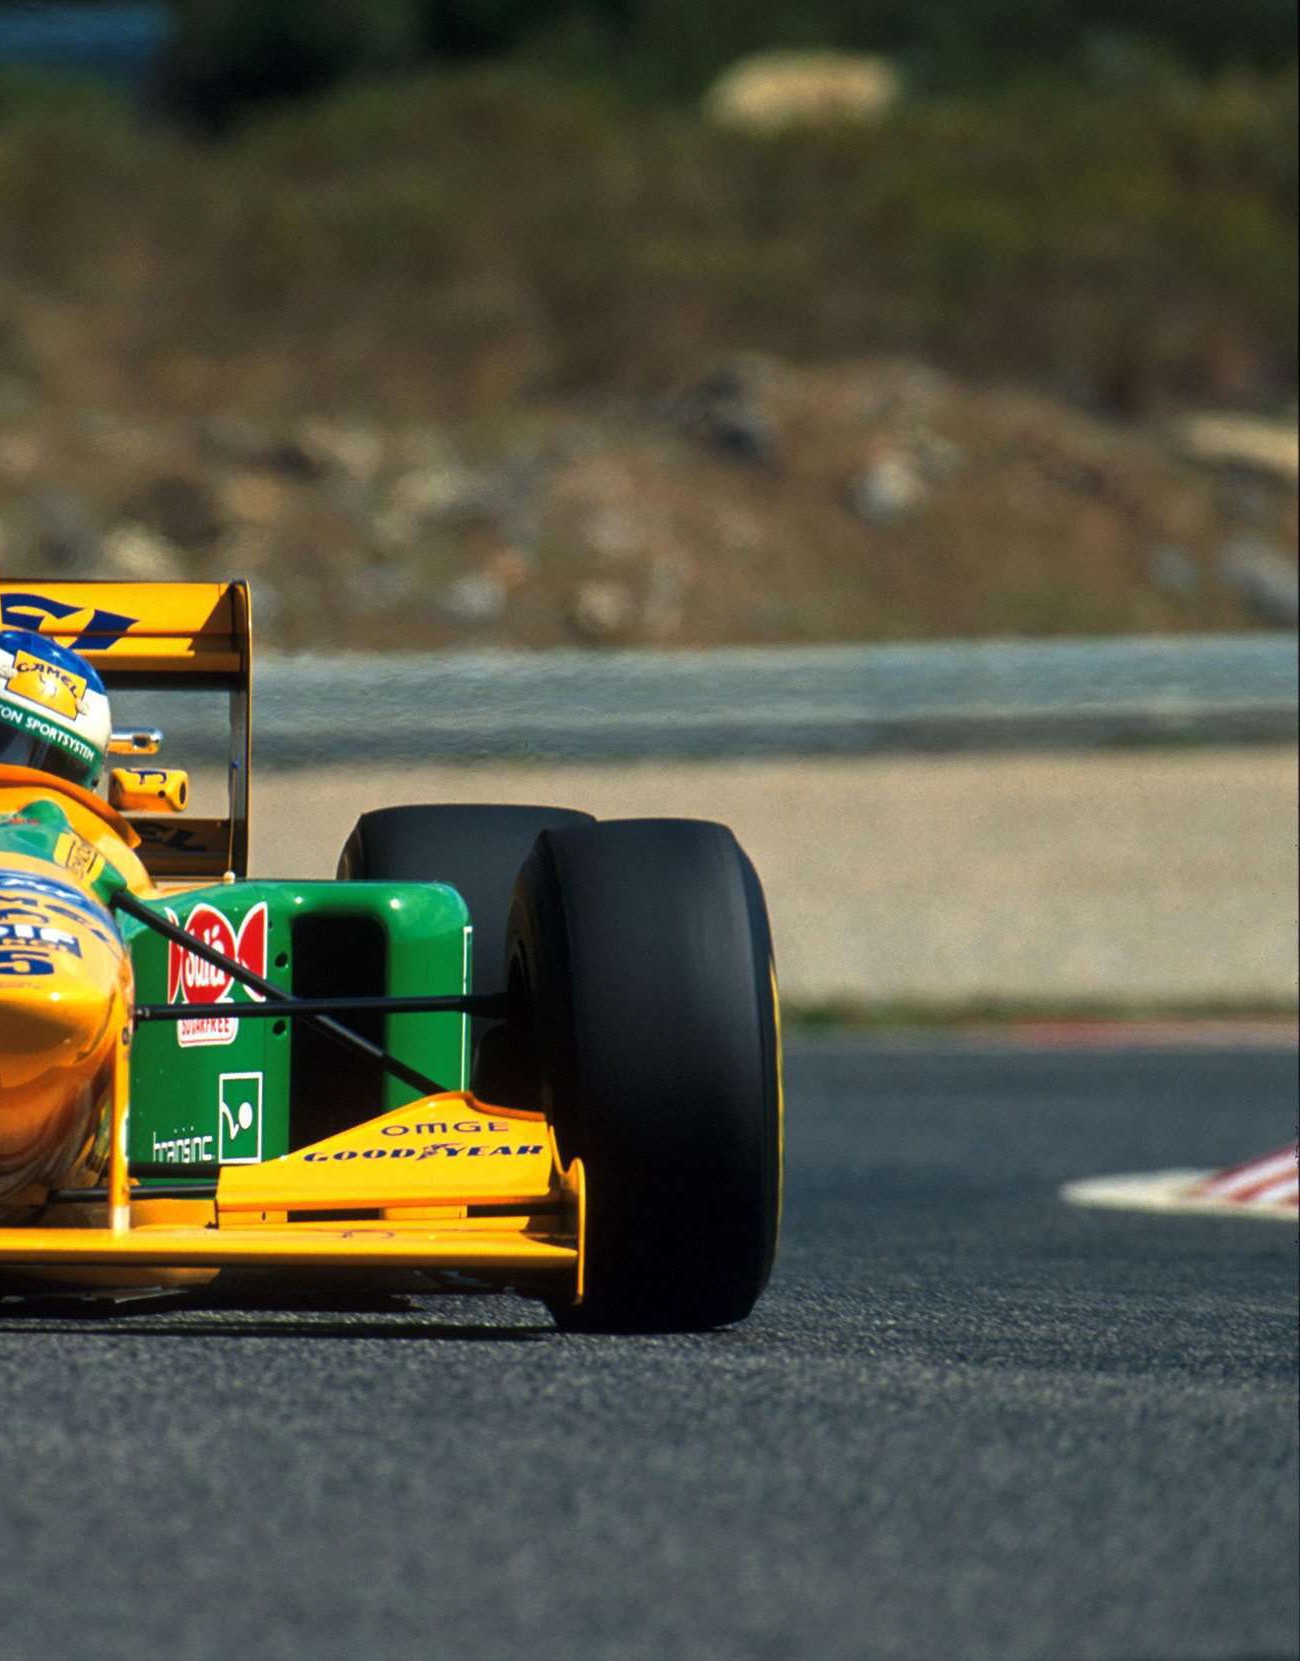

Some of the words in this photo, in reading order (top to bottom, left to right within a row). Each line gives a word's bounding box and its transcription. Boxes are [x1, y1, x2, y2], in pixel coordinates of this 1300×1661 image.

[17, 662, 78, 698] CAMEL
[26, 716, 95, 761] SPORTSYSTEM
[303, 1142, 544, 1162] GOODYEAR
